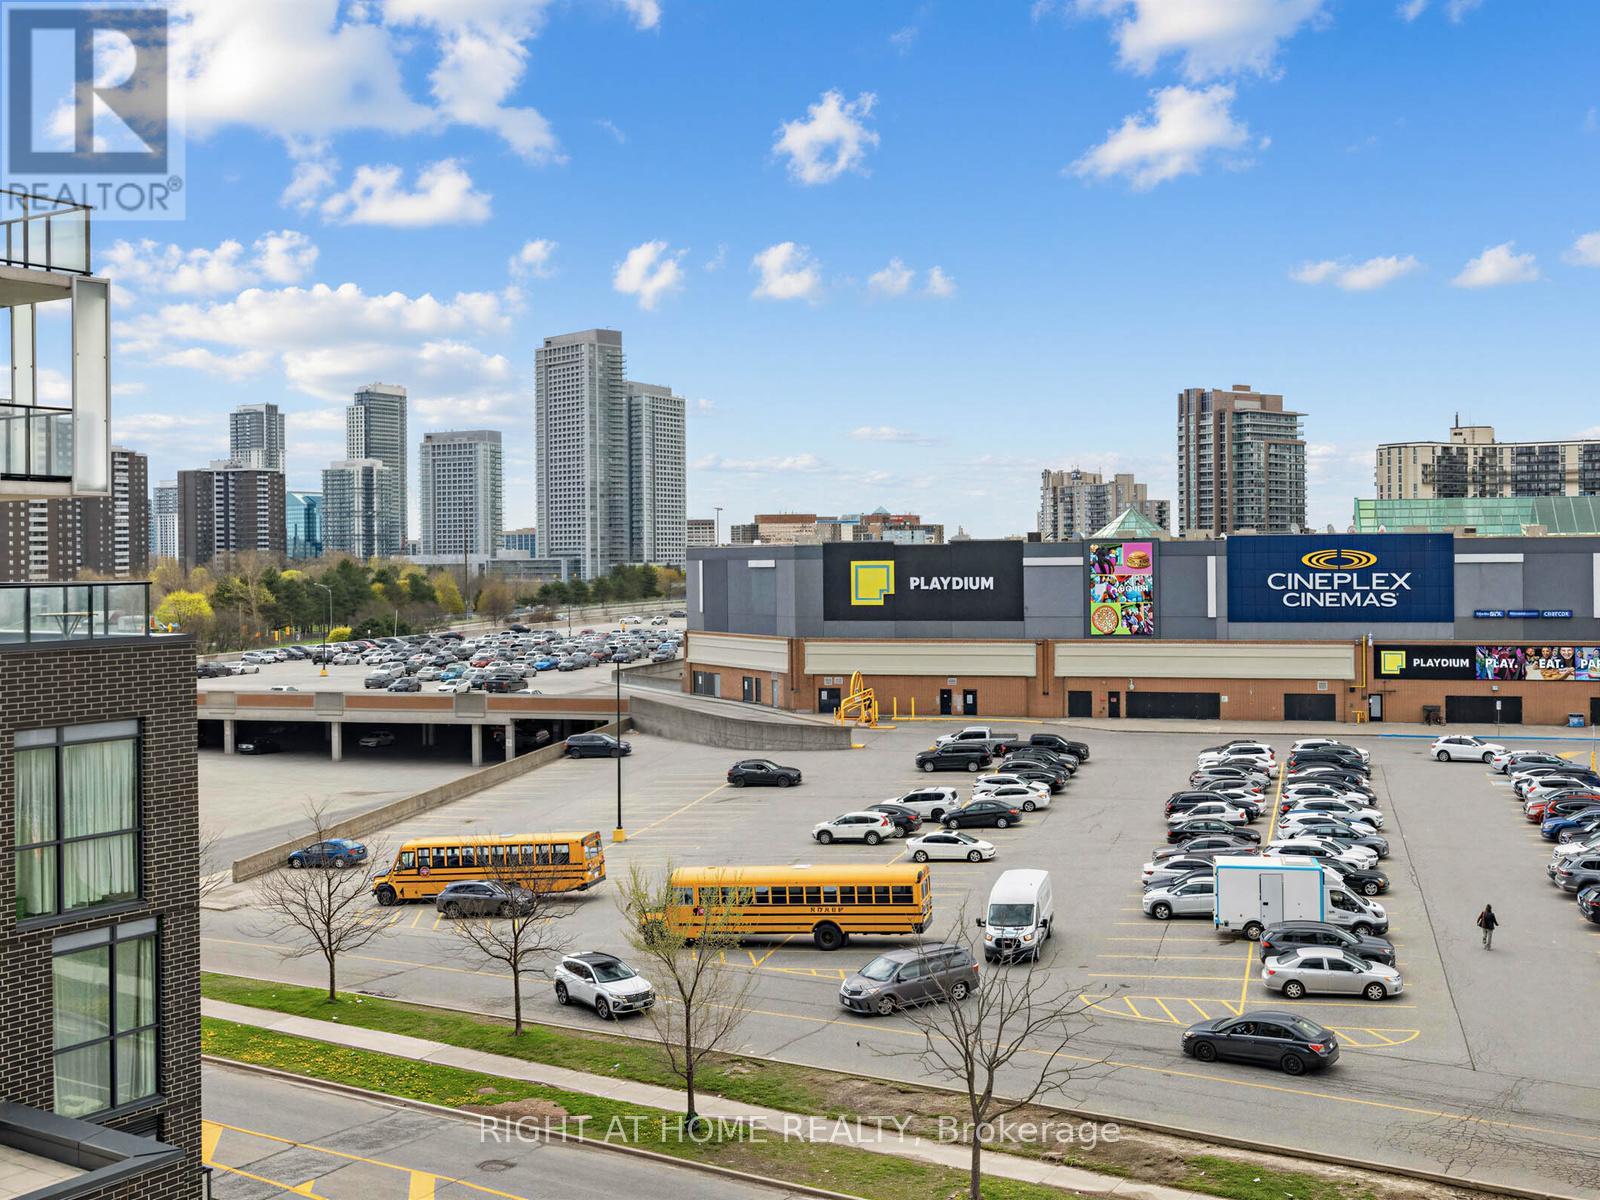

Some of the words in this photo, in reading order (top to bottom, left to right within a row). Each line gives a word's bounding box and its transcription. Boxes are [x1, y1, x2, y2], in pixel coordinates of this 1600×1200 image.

[909, 576, 994, 590] PLAYDIUM
[1267, 572, 1412, 591] CINEPLEX
[1282, 592, 1398, 608] CINEMAS
[1413, 658, 1470, 668] PLAYDIUM
[1485, 658, 1518, 669] PLAY.
[1539, 658, 1564, 669] EAT.
